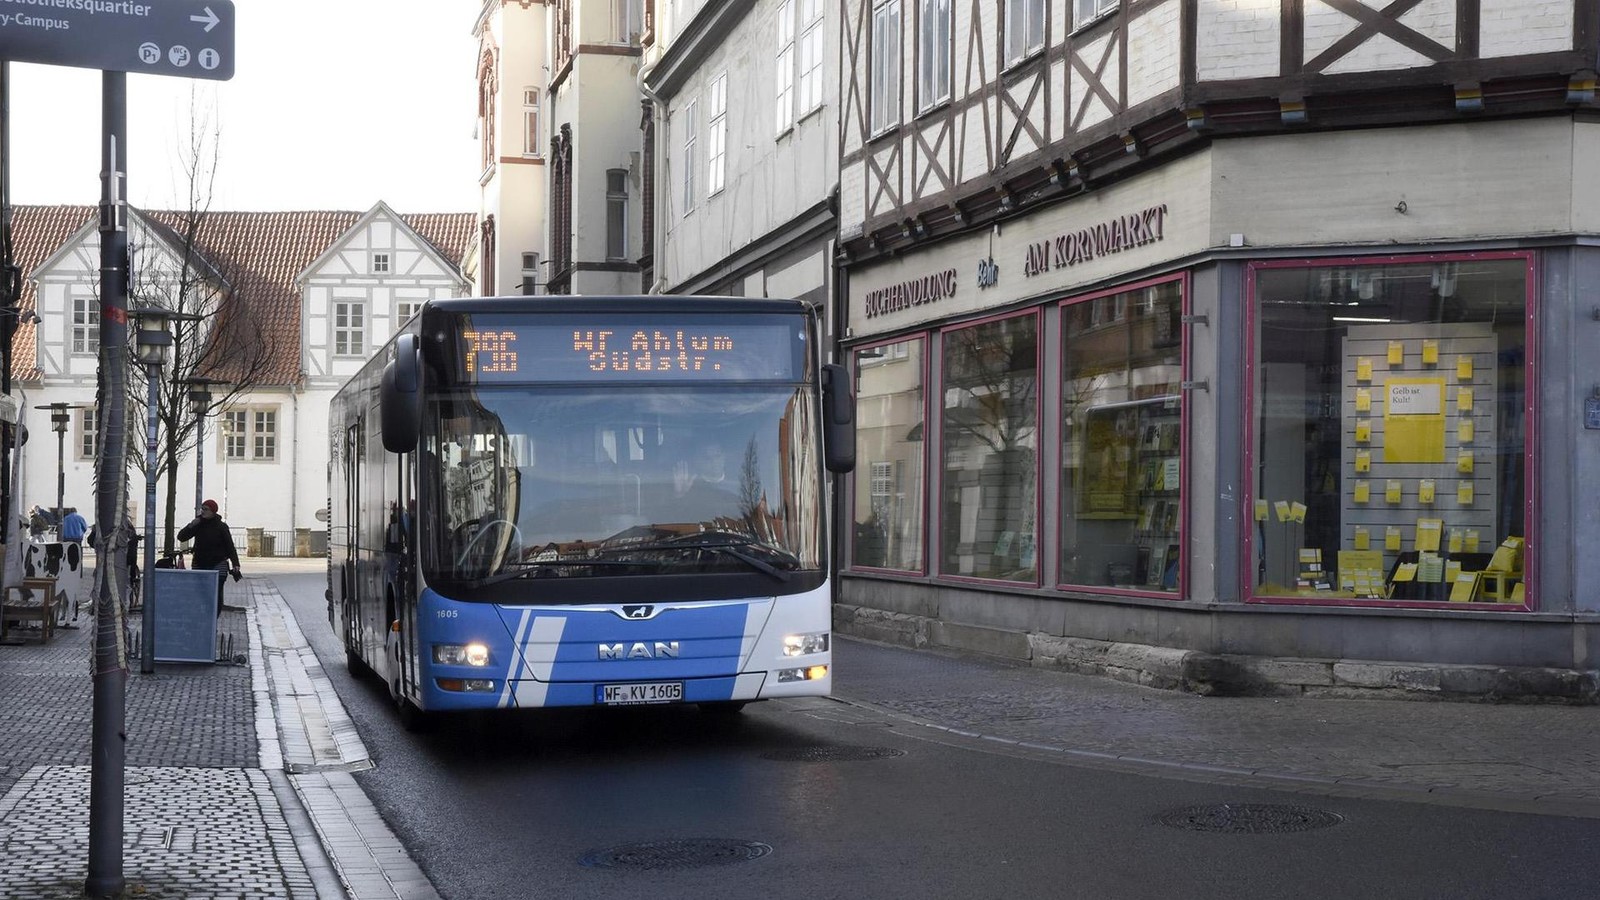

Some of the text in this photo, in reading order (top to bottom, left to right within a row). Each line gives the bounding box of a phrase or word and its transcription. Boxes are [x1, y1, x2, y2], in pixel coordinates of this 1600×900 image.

[865, 267, 957, 319] BUCHHANDLUNG
[1024, 240, 1051, 278] AM
[1054, 203, 1168, 270] KORNMARKT
[632, 331, 733, 351] Ahlum
[463, 331, 517, 372] 796
[589, 351, 721, 371] Südstr.
[1392, 386, 1420, 395] Gelb ist
[436, 610, 458, 619] 1605
[598, 641, 679, 660] MAN
[605, 684, 681, 701] WF KV 1605
